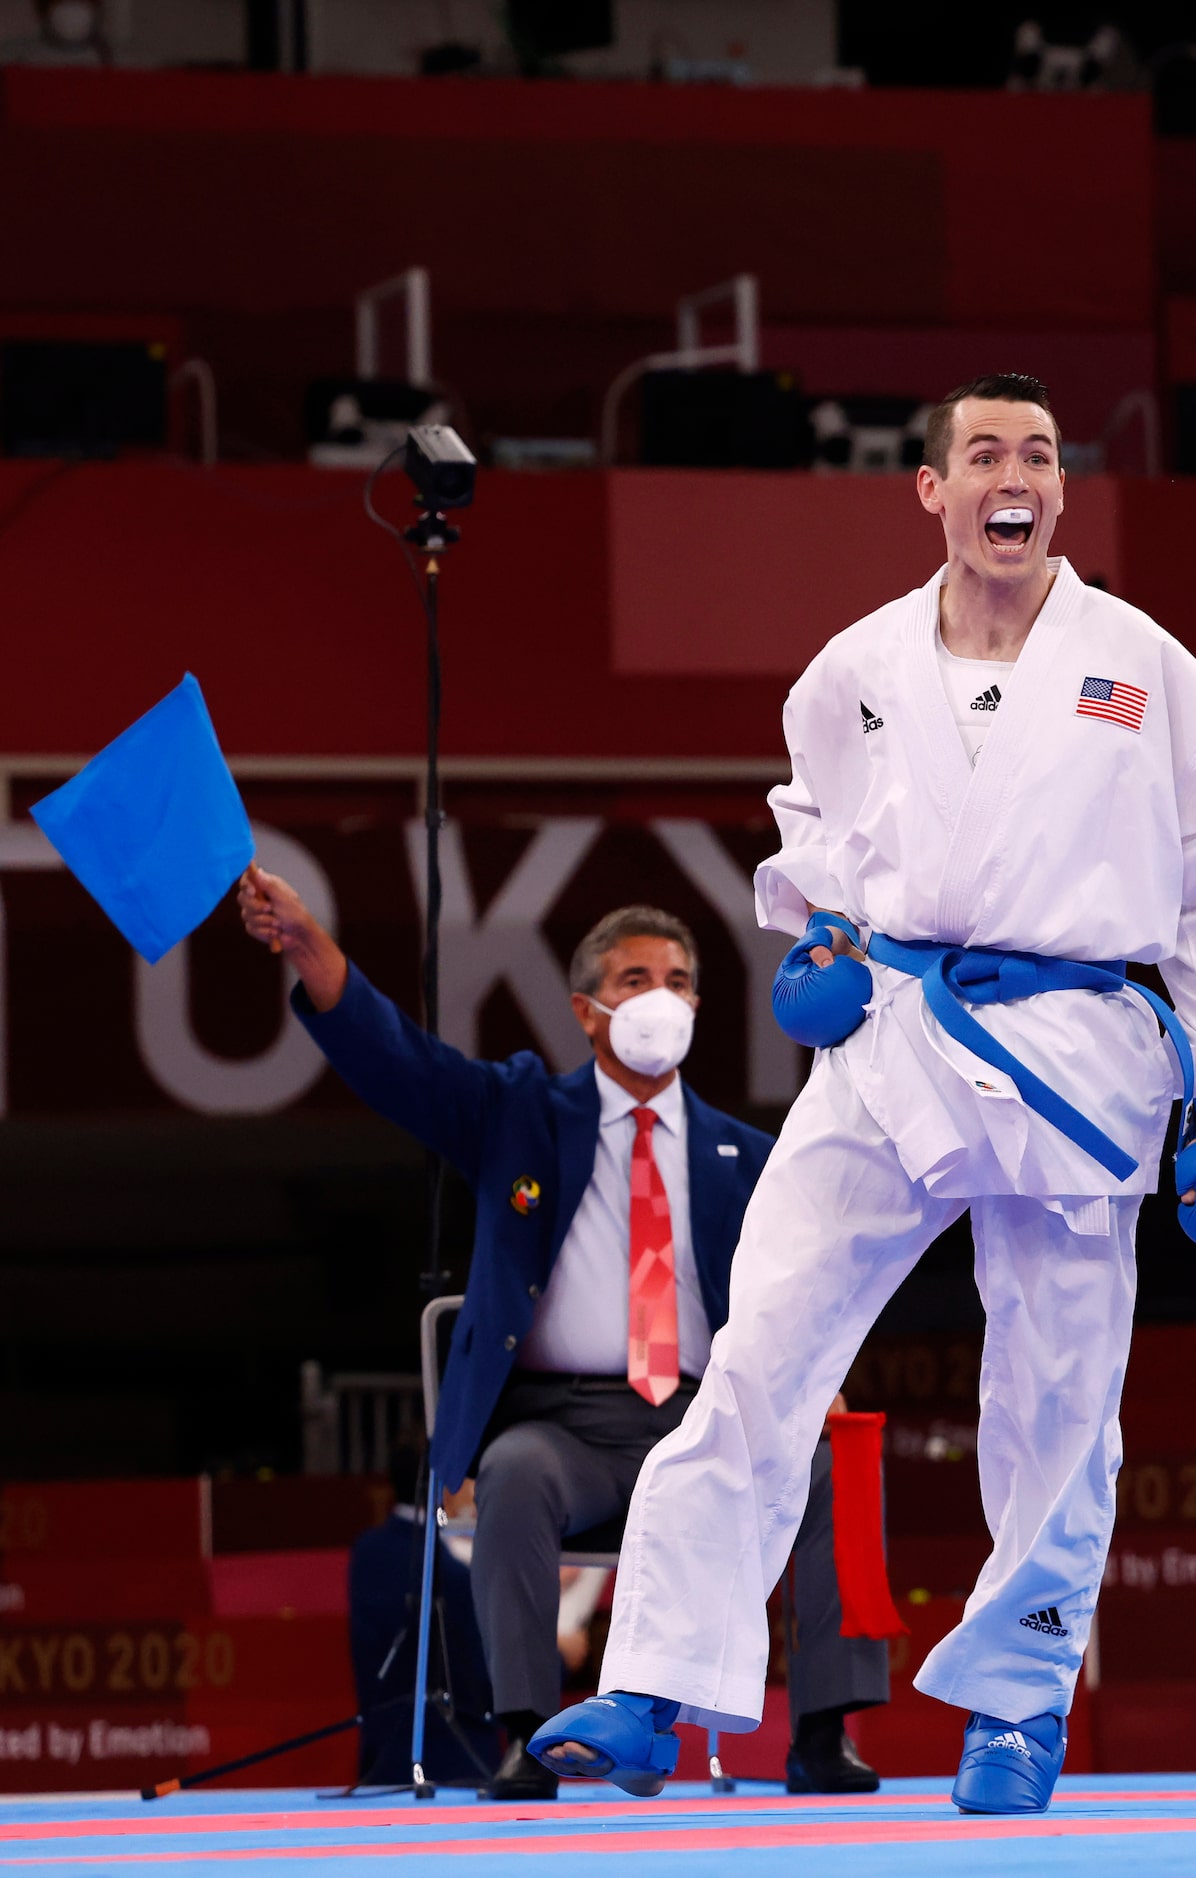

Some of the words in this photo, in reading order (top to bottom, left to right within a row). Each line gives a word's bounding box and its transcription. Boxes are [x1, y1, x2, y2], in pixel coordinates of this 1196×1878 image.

[970, 700, 999, 712] adid
[1019, 1618, 1068, 1636] adidas
[106, 1632, 236, 1691] 2020
[47, 1720, 84, 1767] by
[89, 1718, 211, 1761] Emotion
[987, 1740, 1033, 1759] adidas
